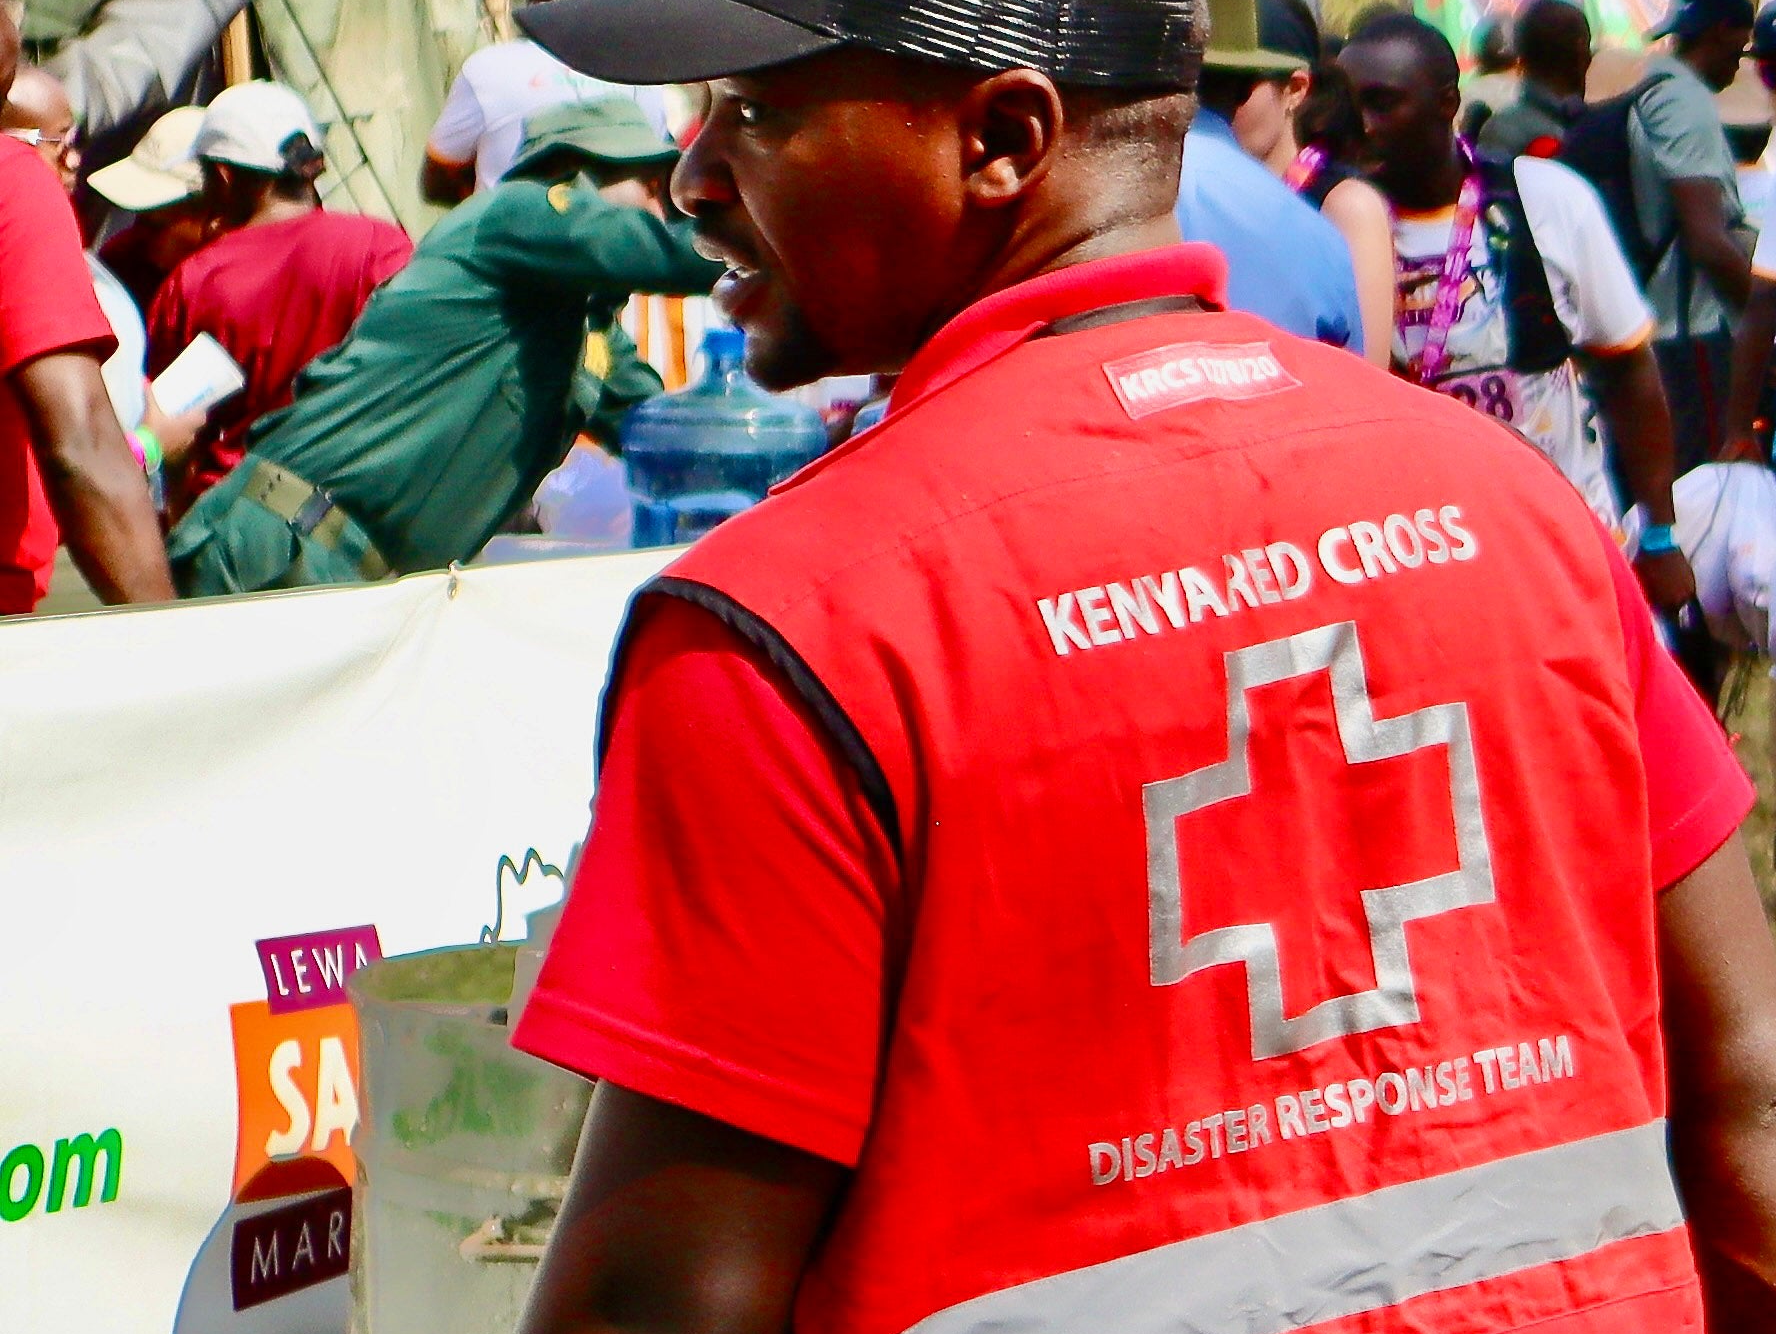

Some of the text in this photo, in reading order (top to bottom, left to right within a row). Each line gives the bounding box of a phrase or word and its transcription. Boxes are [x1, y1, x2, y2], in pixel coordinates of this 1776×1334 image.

[1037, 565, 1230, 656] KENYA
[1317, 504, 1478, 585] CROSS
[1088, 1035, 1574, 1186] DISASTER RESPONSE TEAM
